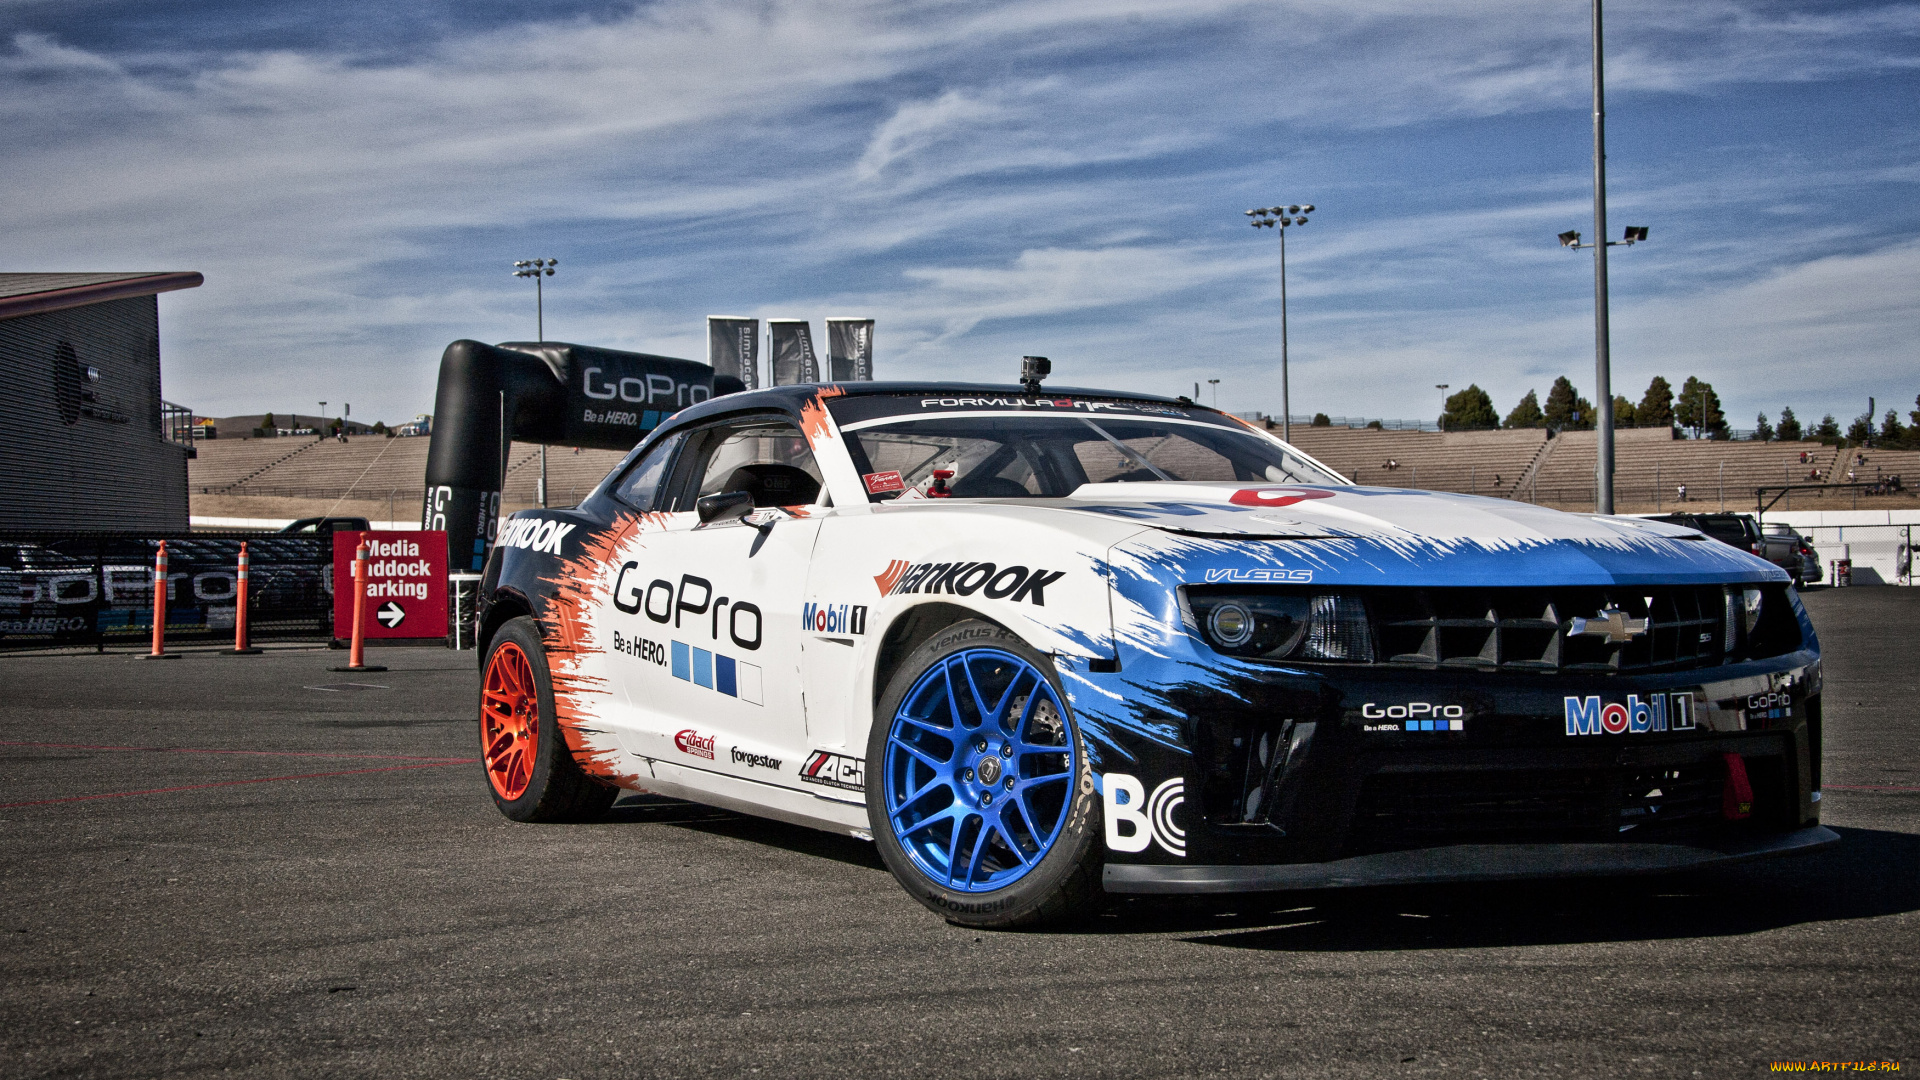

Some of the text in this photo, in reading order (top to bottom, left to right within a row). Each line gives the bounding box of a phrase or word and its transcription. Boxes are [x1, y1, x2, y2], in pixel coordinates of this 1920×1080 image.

[583, 367, 710, 406] GoPro
[584, 409, 638, 425] Be a HERO.
[477, 508, 487, 536] HERO.
[366, 580, 428, 600] arking
[613, 560, 763, 651] GoPro
[803, 602, 864, 634] Mobil 1
[614, 630, 667, 667] Be a HERO.
[1362, 702, 1463, 718] GoPro
[1748, 693, 1790, 708] GoPro
[1564, 694, 1667, 736] Mobil
[674, 729, 715, 753] Eibach
[686, 746, 712, 759] SPRINGS
[731, 746, 782, 770] forgestar
